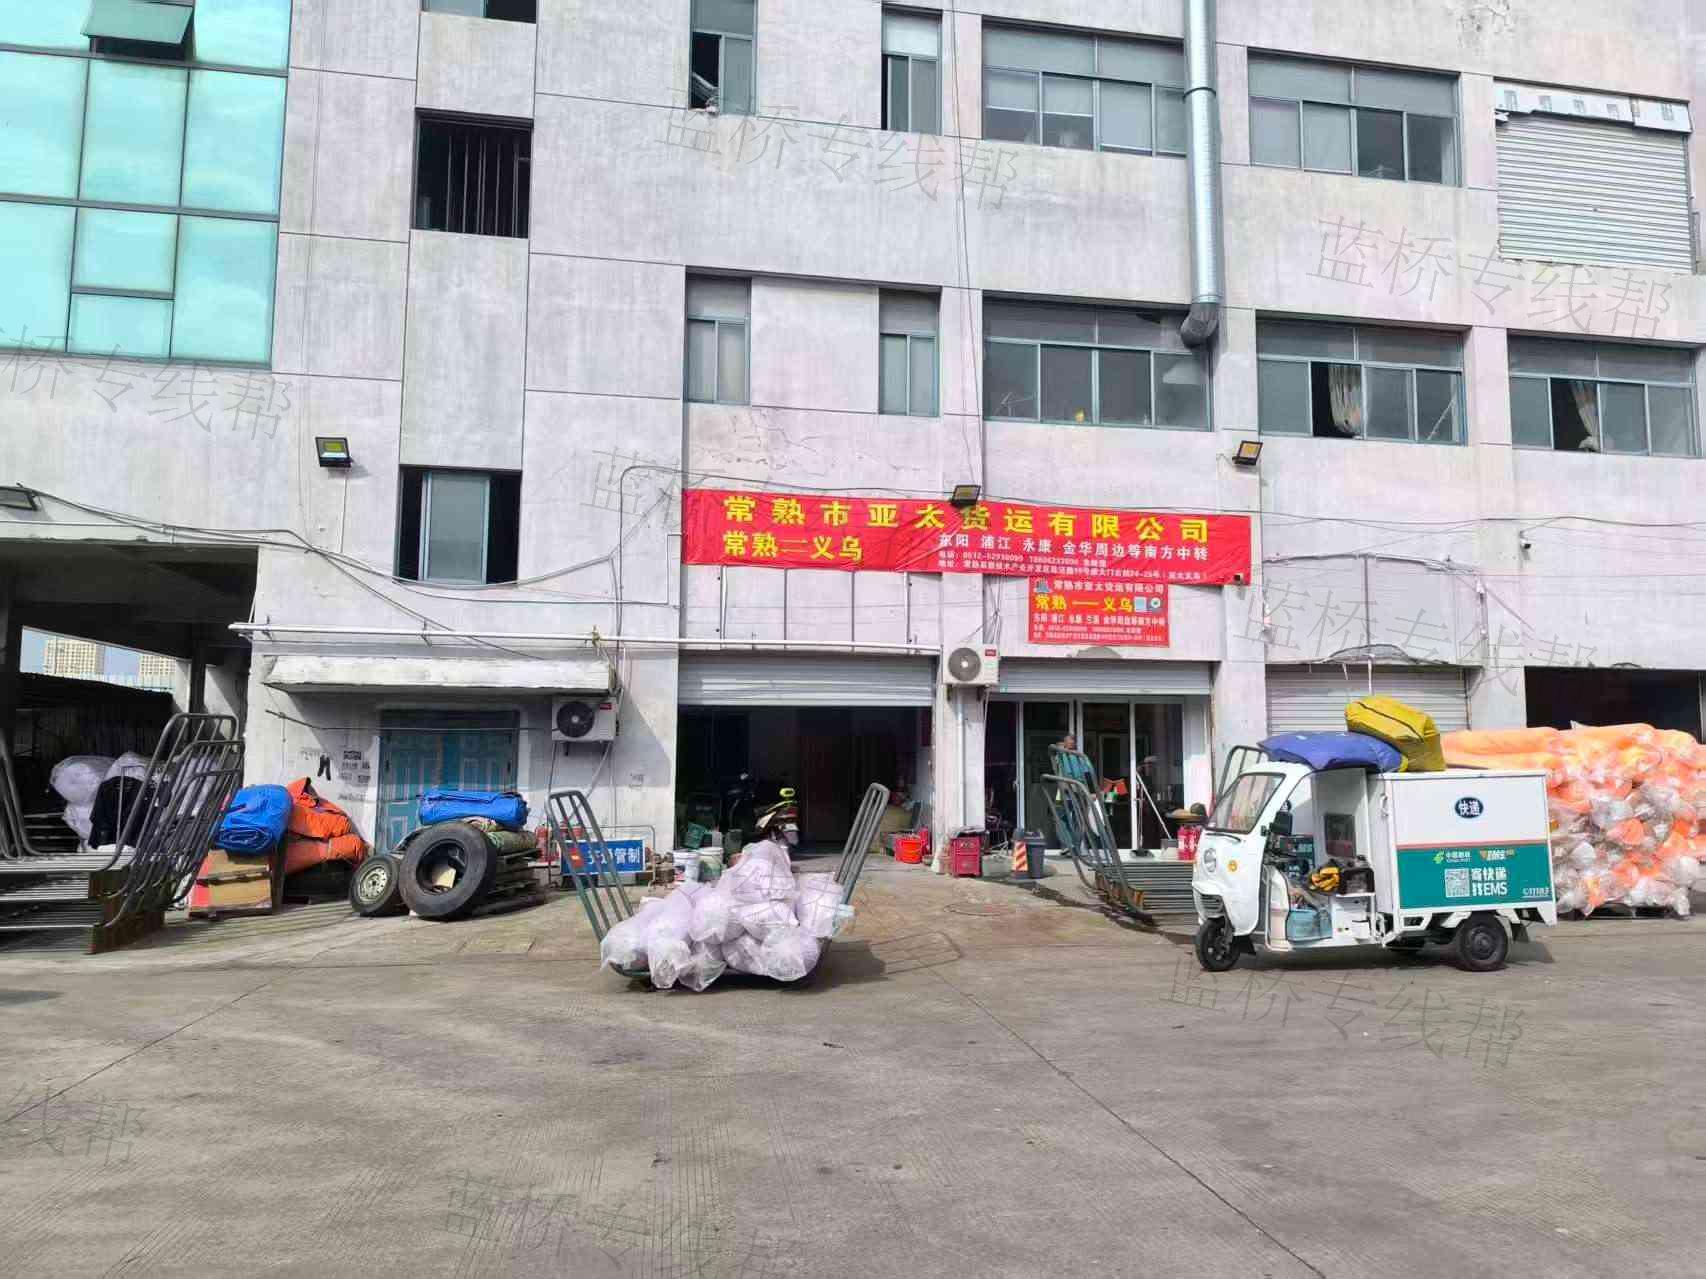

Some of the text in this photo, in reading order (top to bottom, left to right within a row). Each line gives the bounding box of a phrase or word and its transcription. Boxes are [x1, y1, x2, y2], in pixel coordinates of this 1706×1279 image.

[723, 495, 1210, 544] 常熟市亚太货运有限公司
